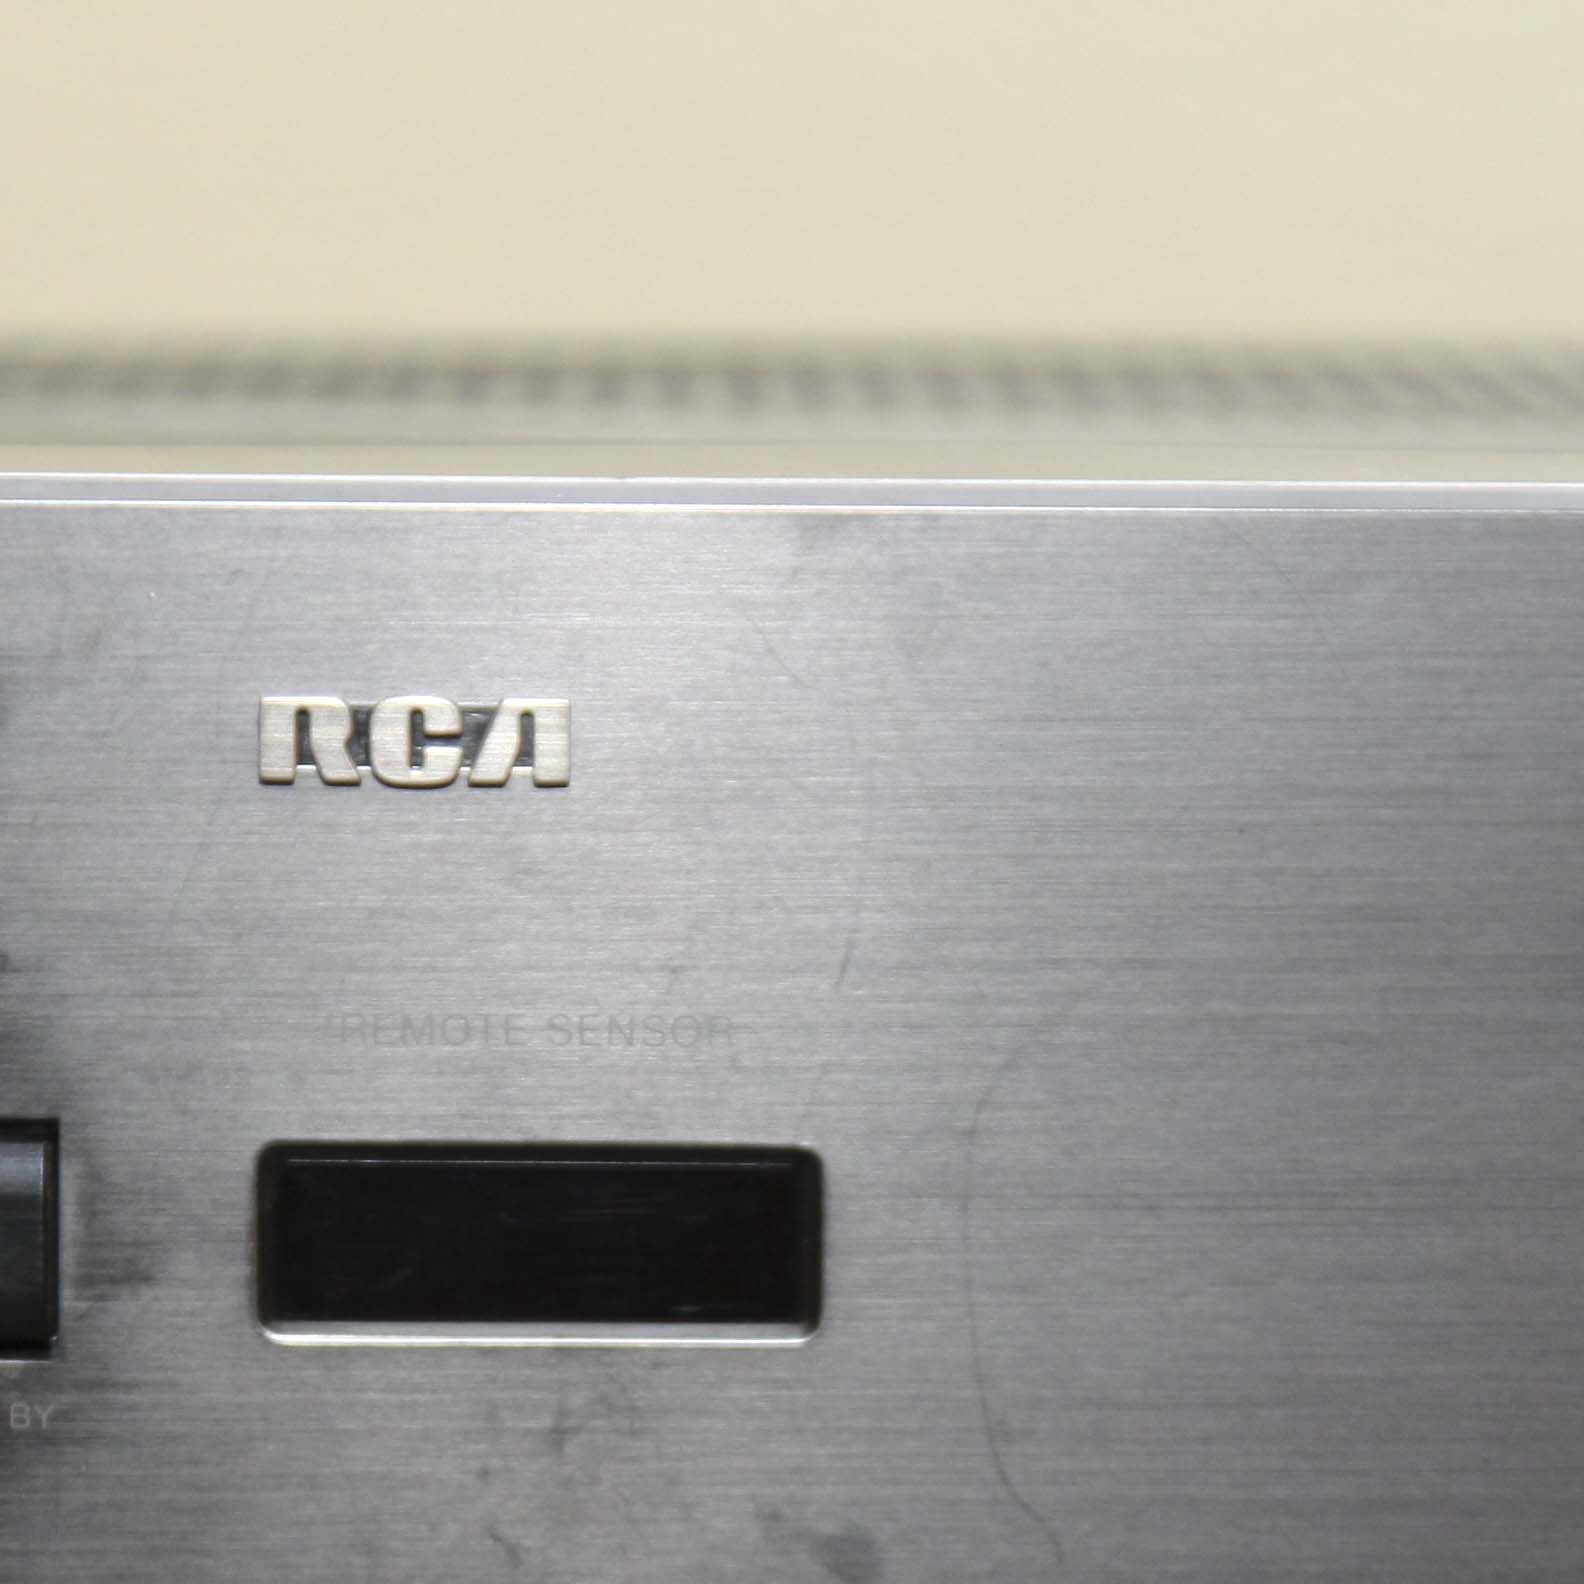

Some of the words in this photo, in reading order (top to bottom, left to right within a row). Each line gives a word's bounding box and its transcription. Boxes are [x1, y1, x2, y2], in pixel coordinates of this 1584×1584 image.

[259, 695, 571, 788] RCA
[340, 1013, 520, 1048] REMOTE
[547, 1014, 734, 1049] SENSOR
[10, 1404, 56, 1430] BY
